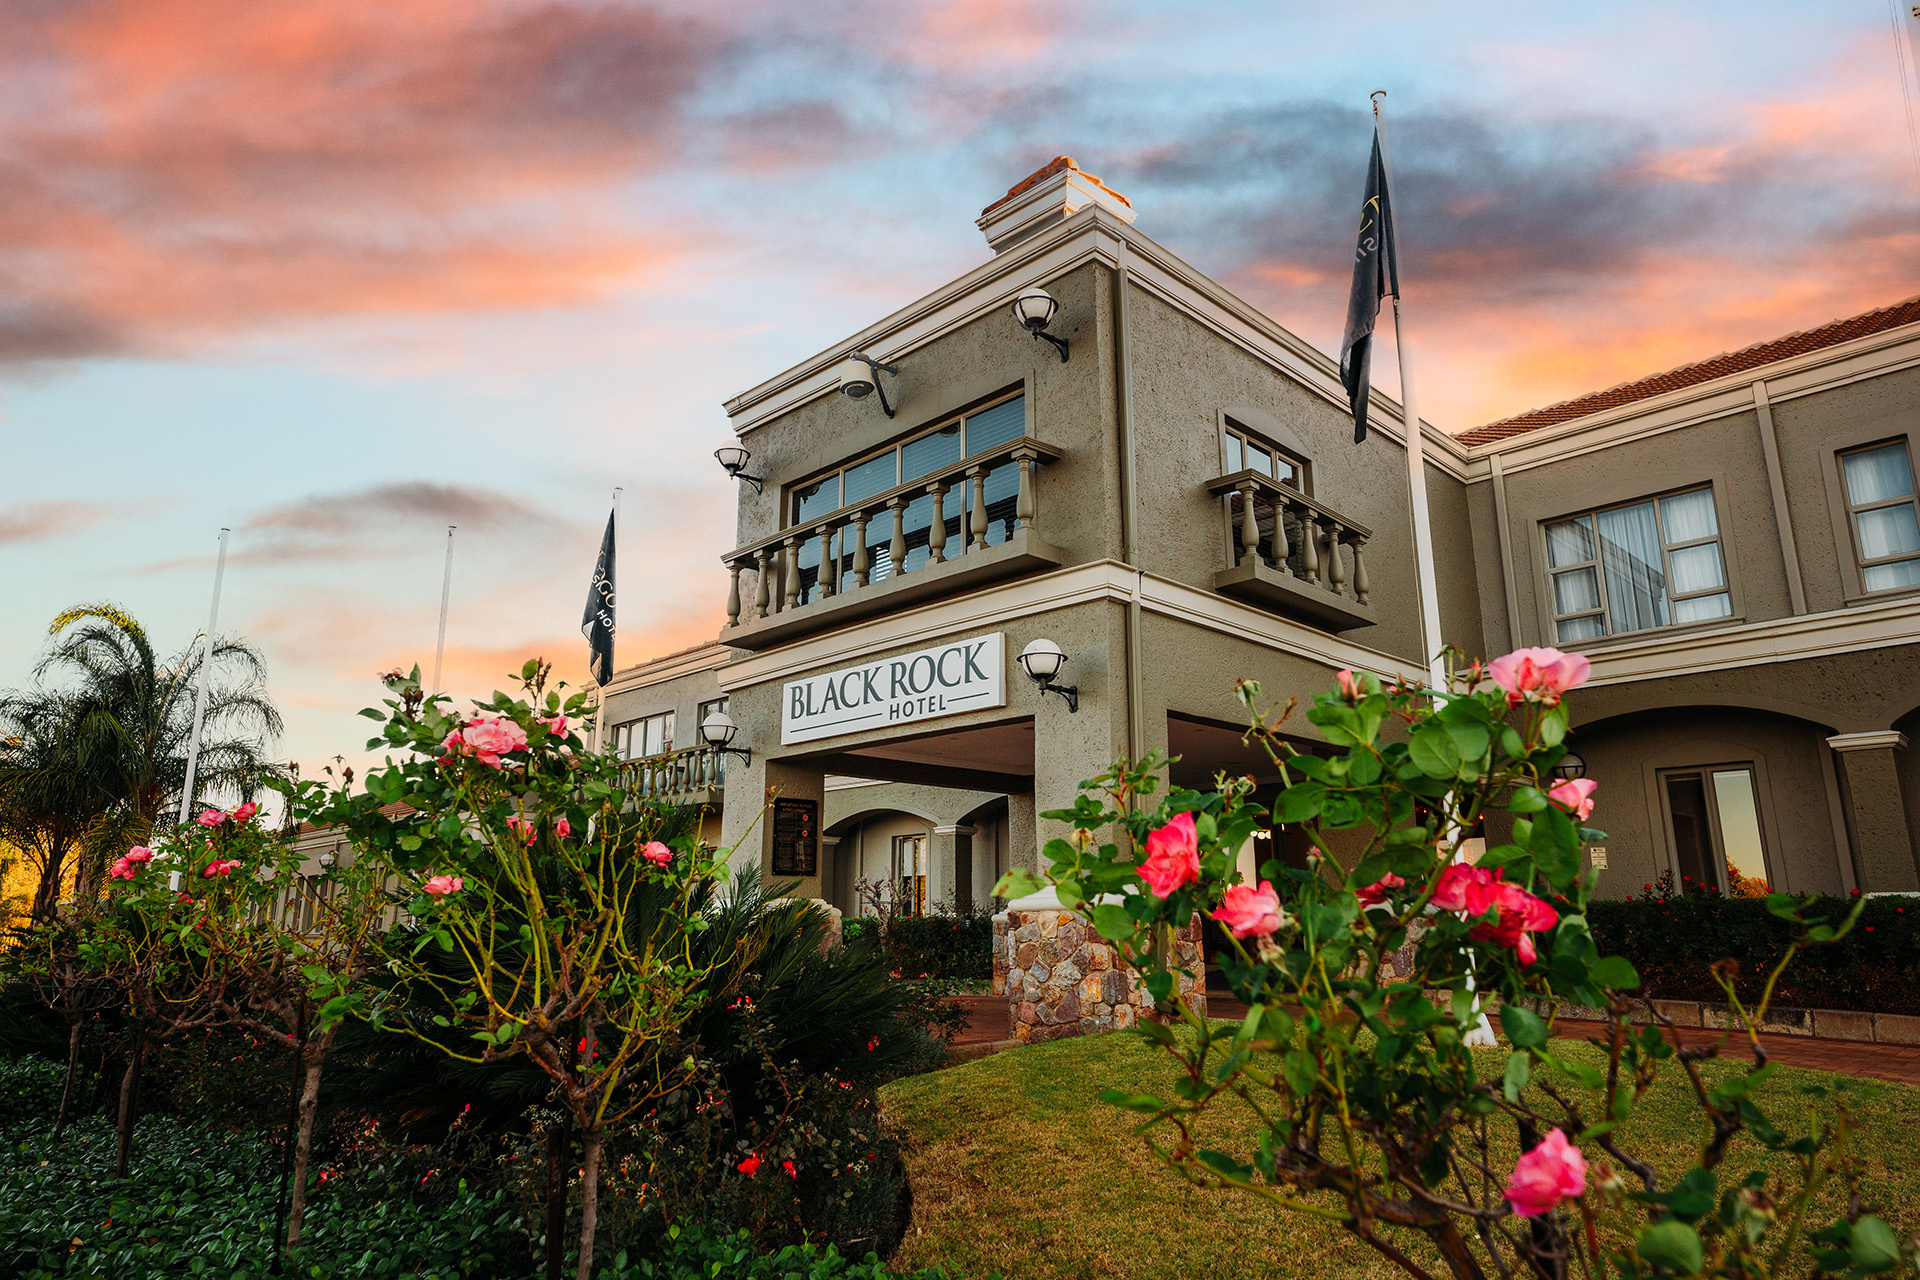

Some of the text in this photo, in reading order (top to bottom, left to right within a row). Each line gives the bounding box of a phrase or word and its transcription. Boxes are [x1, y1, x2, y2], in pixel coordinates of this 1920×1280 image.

[790, 641, 990, 720] BLACK ROCK
[889, 694, 947, 720] HOTEL
